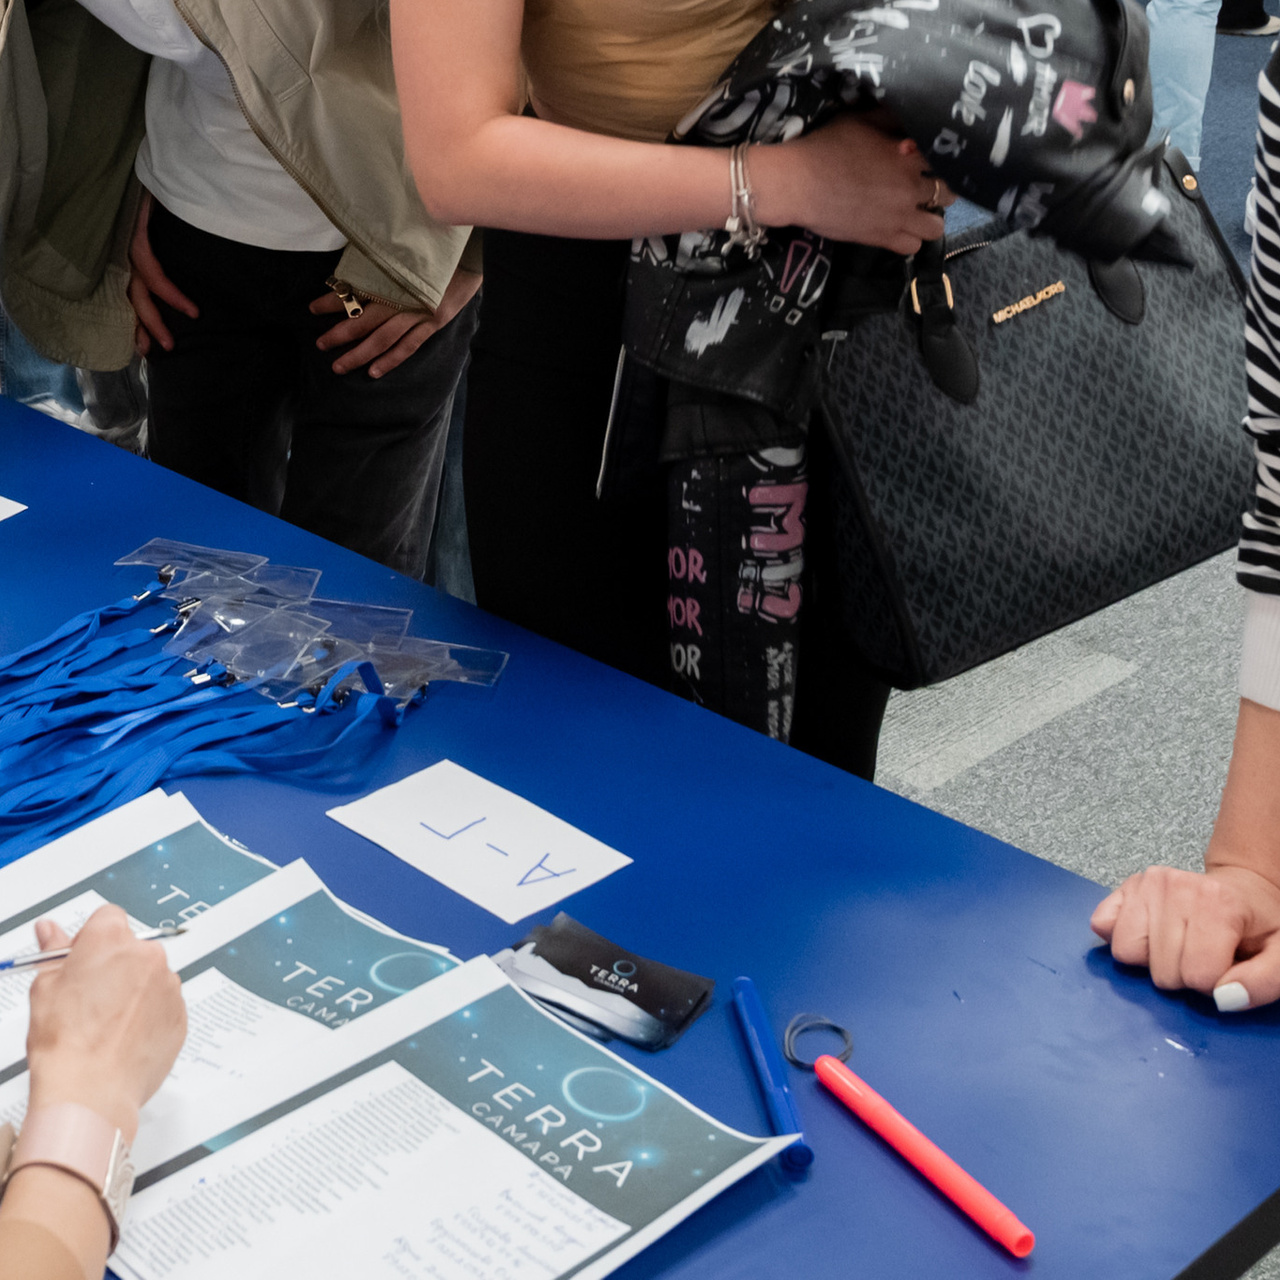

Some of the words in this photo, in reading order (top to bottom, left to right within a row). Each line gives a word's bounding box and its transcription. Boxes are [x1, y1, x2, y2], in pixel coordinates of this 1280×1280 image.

[282, 960, 374, 1013] TER
[589, 963, 639, 994] TERRA
[467, 1058, 634, 1189] TERRA
